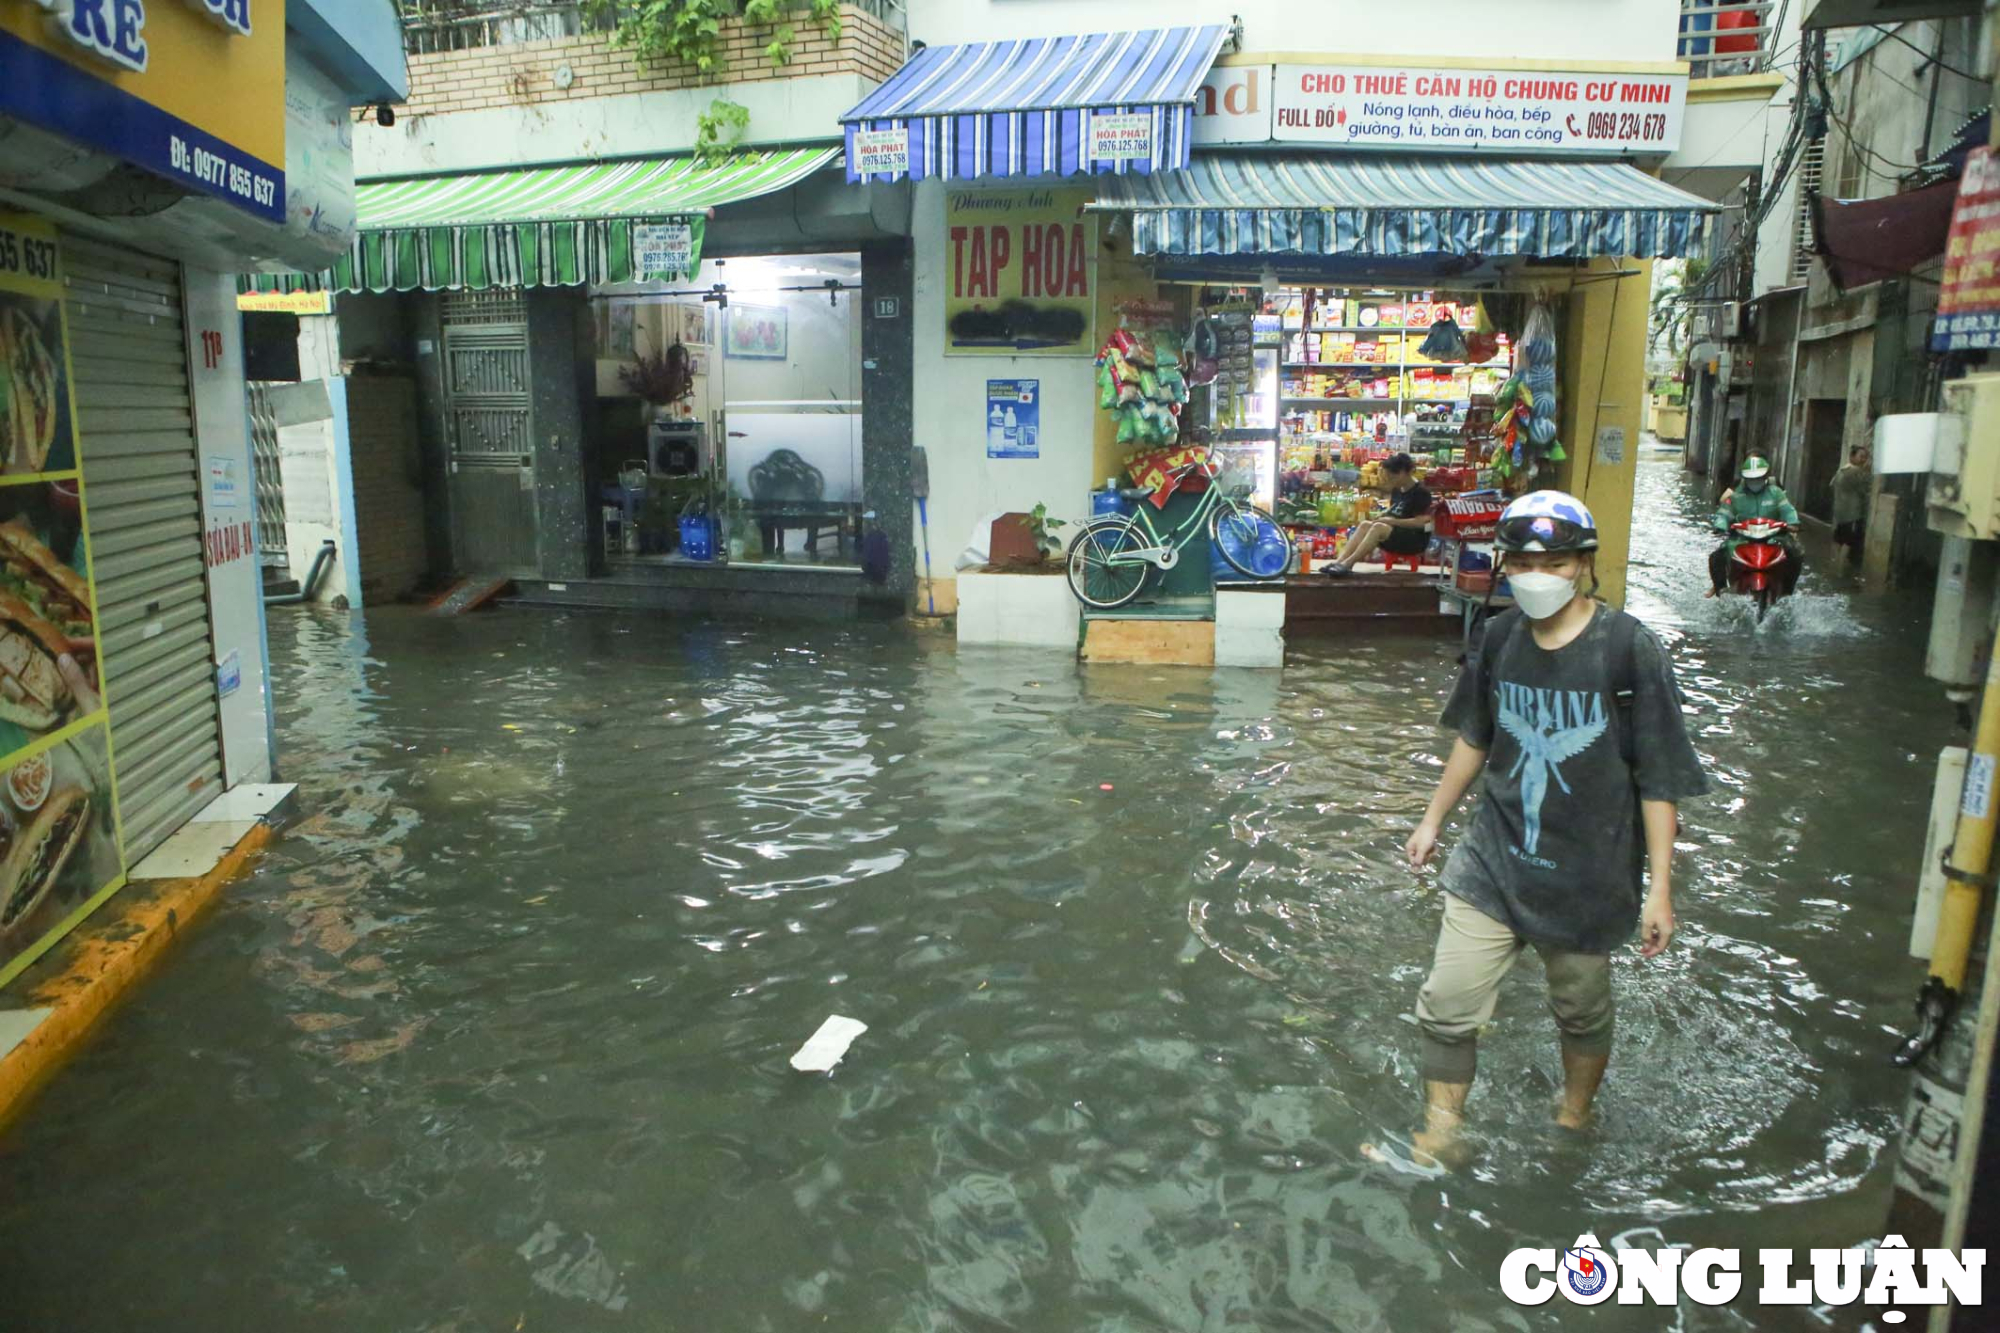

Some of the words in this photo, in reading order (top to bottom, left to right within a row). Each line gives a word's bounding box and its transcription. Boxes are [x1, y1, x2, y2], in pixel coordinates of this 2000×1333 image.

[1301, 73, 1346, 94] CHO
[1353, 71, 1408, 96] THUÊ
[1415, 73, 1461, 97] CĂN
[1467, 75, 1497, 103] HỘ
[1504, 79, 1578, 101] CHUNG
[1585, 80, 1618, 102] CƯ
[1620, 83, 1672, 104] MINI
[1278, 108, 1311, 128] FULL
[1362, 102, 1404, 120] Nóng
[1407, 103, 1444, 121] lạnh,
[1448, 102, 1481, 120] điều
[1485, 105, 1518, 122] hòa,
[1522, 106, 1551, 124] bếp
[1348, 120, 1404, 139] giường,
[1408, 119, 1426, 137] tủ,
[1431, 124, 1460, 138] bàn
[1464, 124, 1487, 140] ăn,
[1491, 124, 1521, 139] ban
[1524, 126, 1563, 144] công
[1587, 111, 1617, 140] 0969
[1618, 112, 1640, 141] 234
[1642, 113, 1667, 141] 678
[1098, 140, 1148, 151] 0976.125.768
[862, 153, 906, 166] 0976.125.768
[194, 146, 227, 188] 0977
[229, 163, 252, 199] 855
[254, 174, 275, 208] 637
[24, 237, 56, 280] 637
[880, 300, 894, 314] 18
[1499, 680, 1603, 732] NIRVANA
